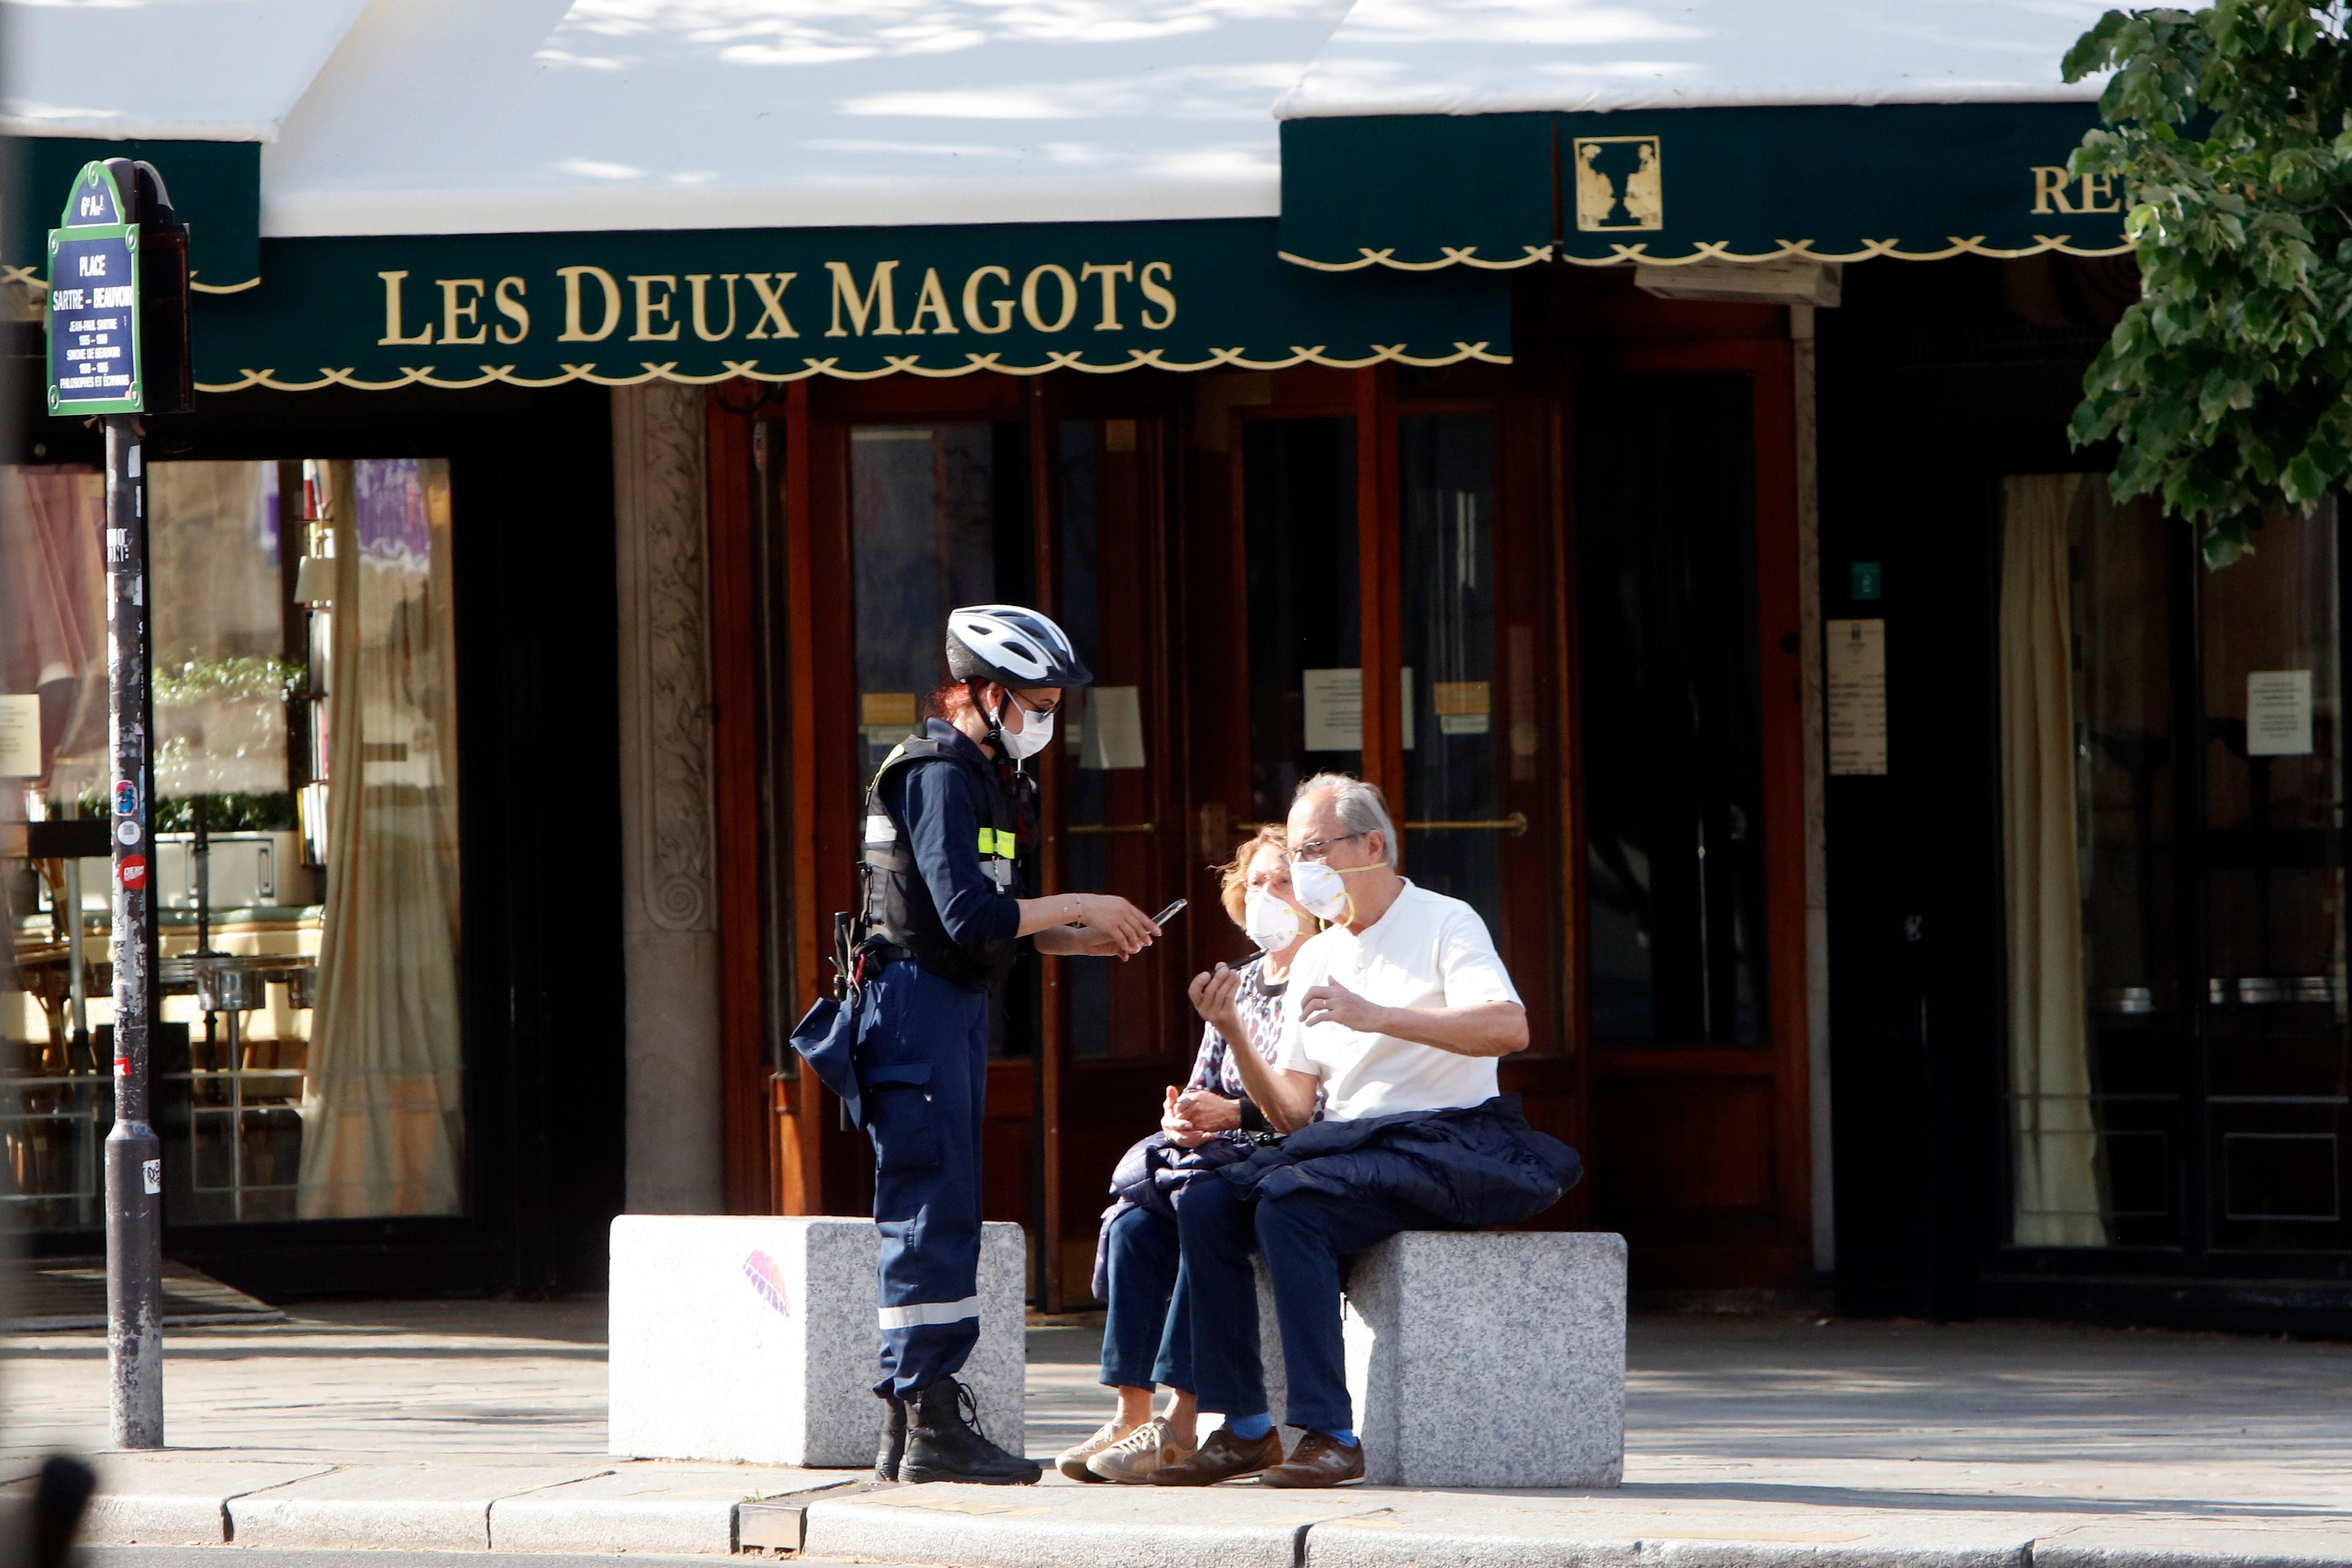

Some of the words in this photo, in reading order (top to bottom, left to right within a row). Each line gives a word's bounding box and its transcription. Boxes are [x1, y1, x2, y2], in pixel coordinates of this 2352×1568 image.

[2030, 166, 2139, 214] RE
[80, 254, 106, 277] PLACE
[53, 288, 84, 311] SARTRE
[93, 285, 133, 309] BEAUVOIR
[377, 270, 530, 346] LES
[556, 265, 800, 342] DEUX
[824, 259, 1177, 337] MAGOTS
